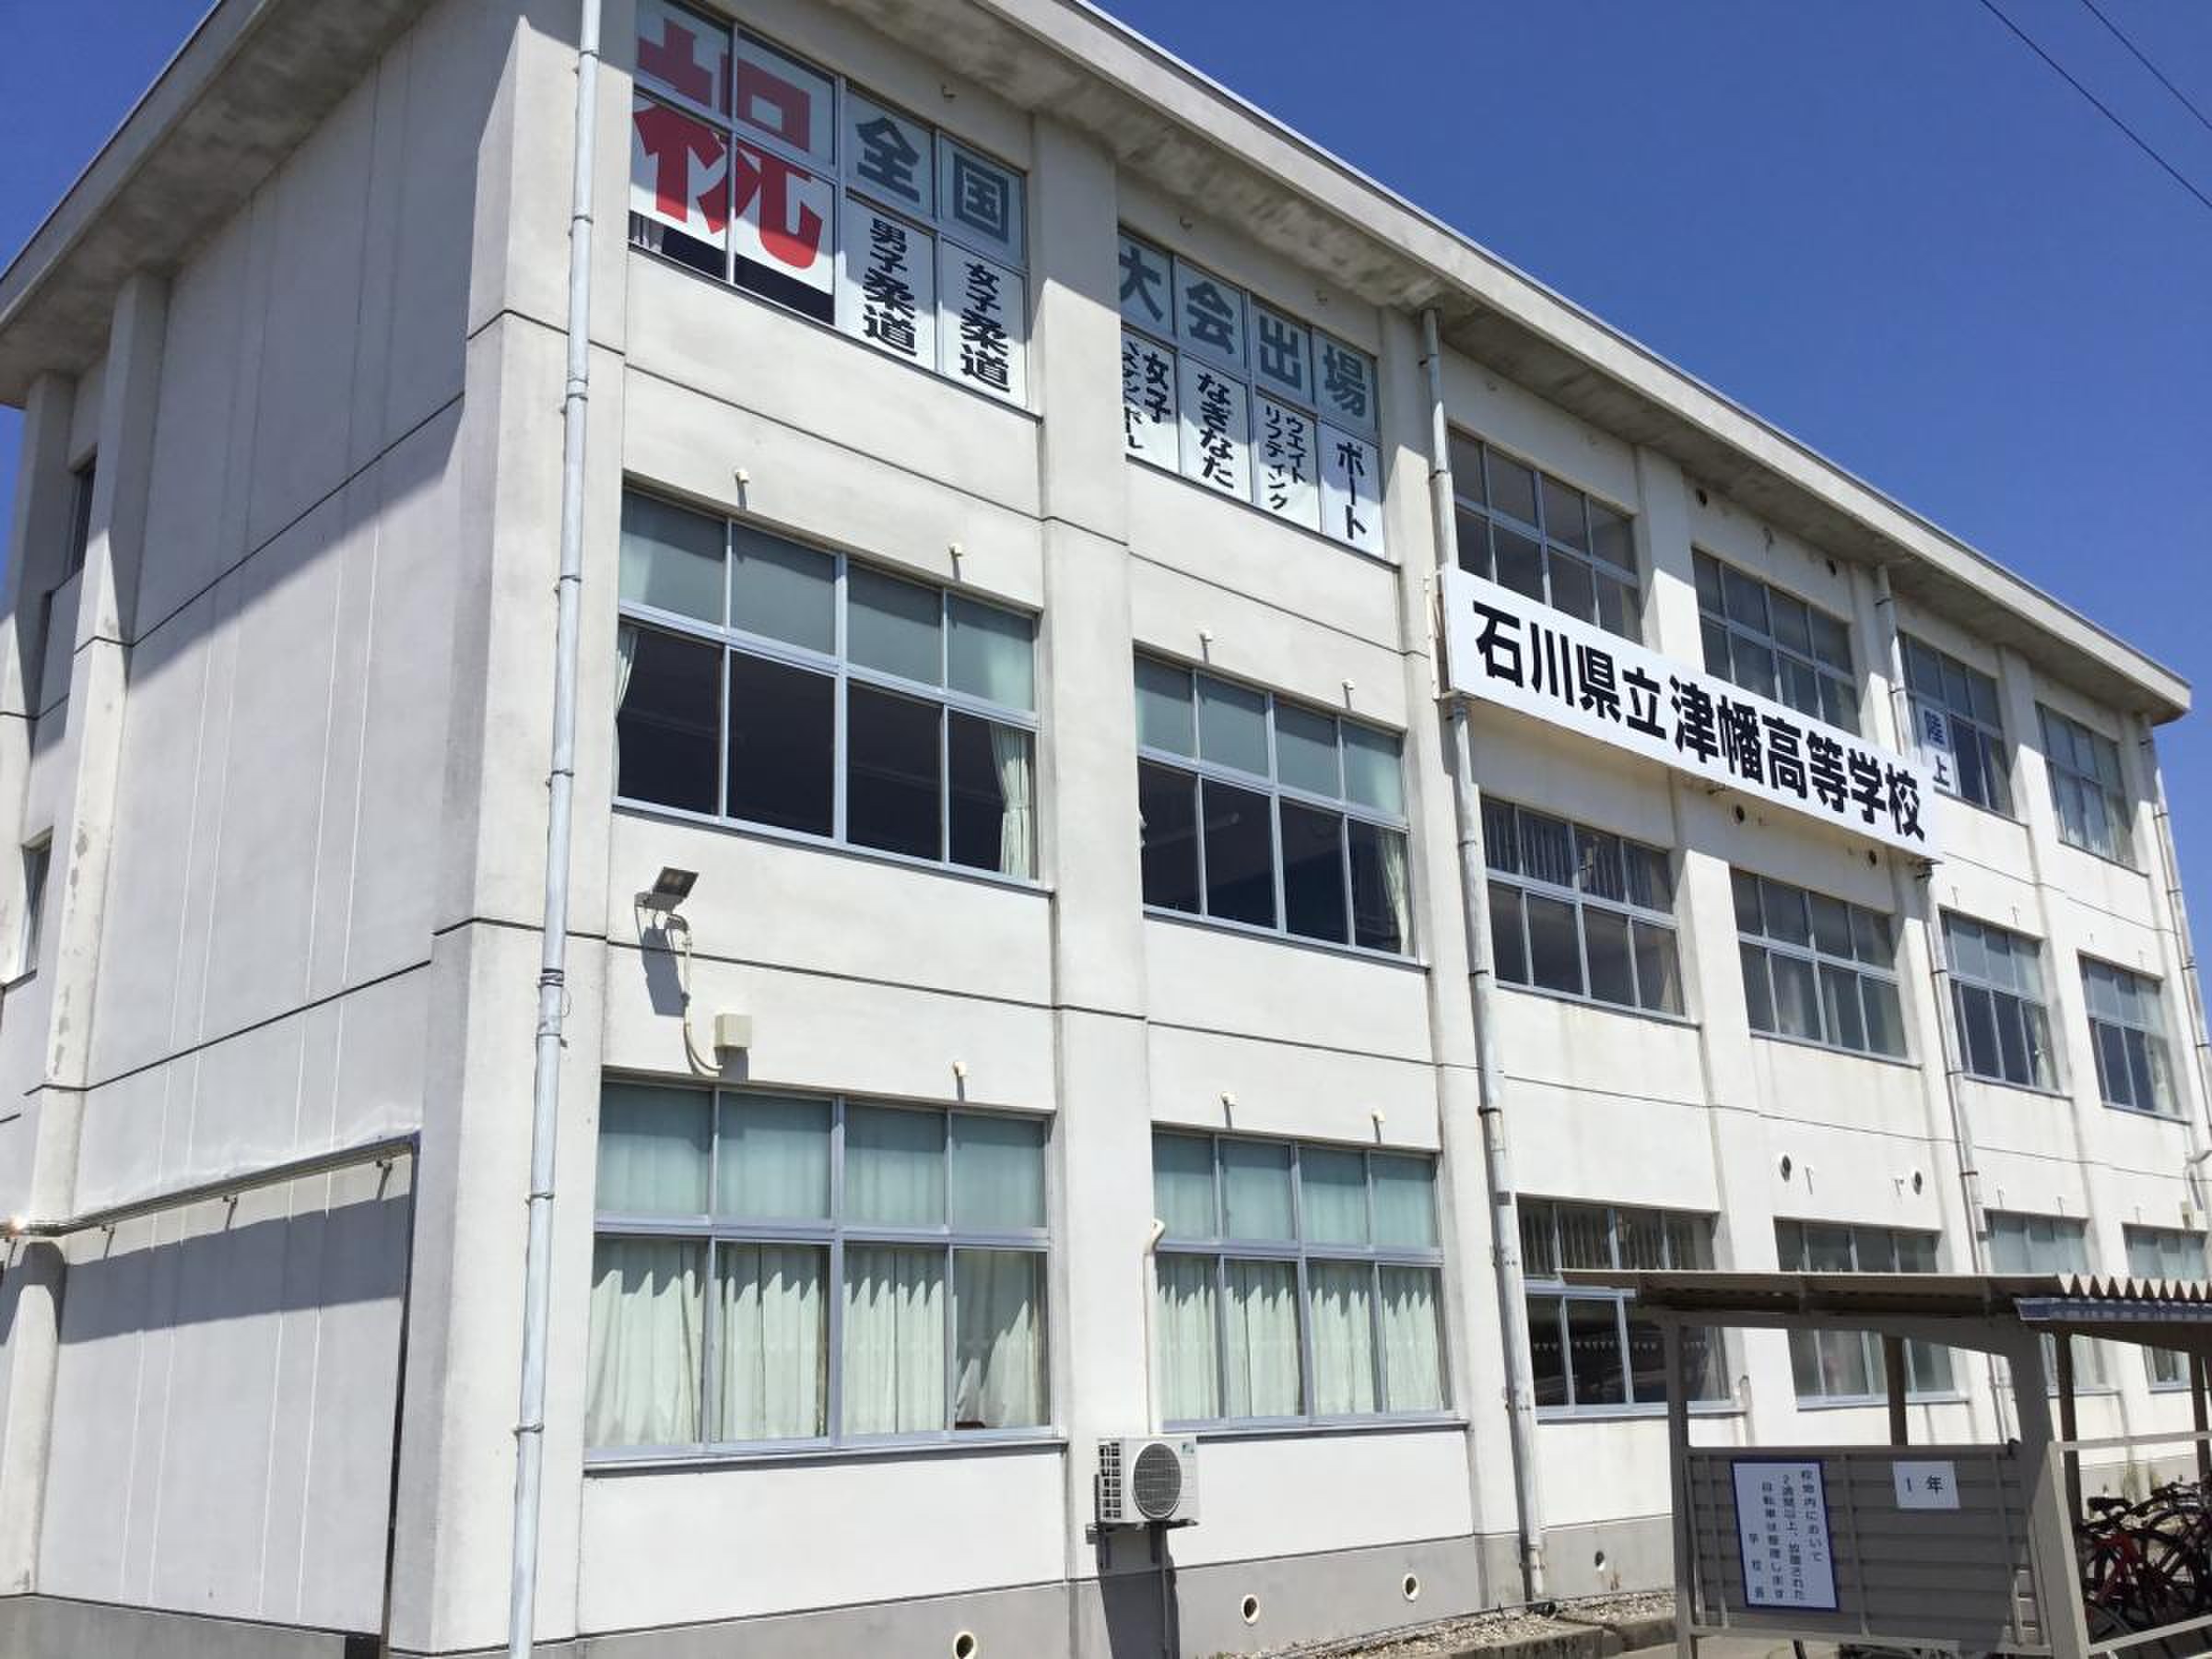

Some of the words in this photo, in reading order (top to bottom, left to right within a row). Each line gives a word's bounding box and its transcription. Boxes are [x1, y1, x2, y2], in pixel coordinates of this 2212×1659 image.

[634, 18, 823, 270] 祝
[863, 218, 917, 357] 男子柔道
[960, 261, 1011, 394] 女子柔道
[1143, 351, 1171, 424] 女子
[1197, 371, 1235, 490] なぎなた
[1265, 404, 1288, 511] リフティング
[1335, 441, 1368, 540] ボート
[1473, 599, 1925, 842] 石川県立津幡高等学校
[1924, 710, 1950, 787] 陸上
